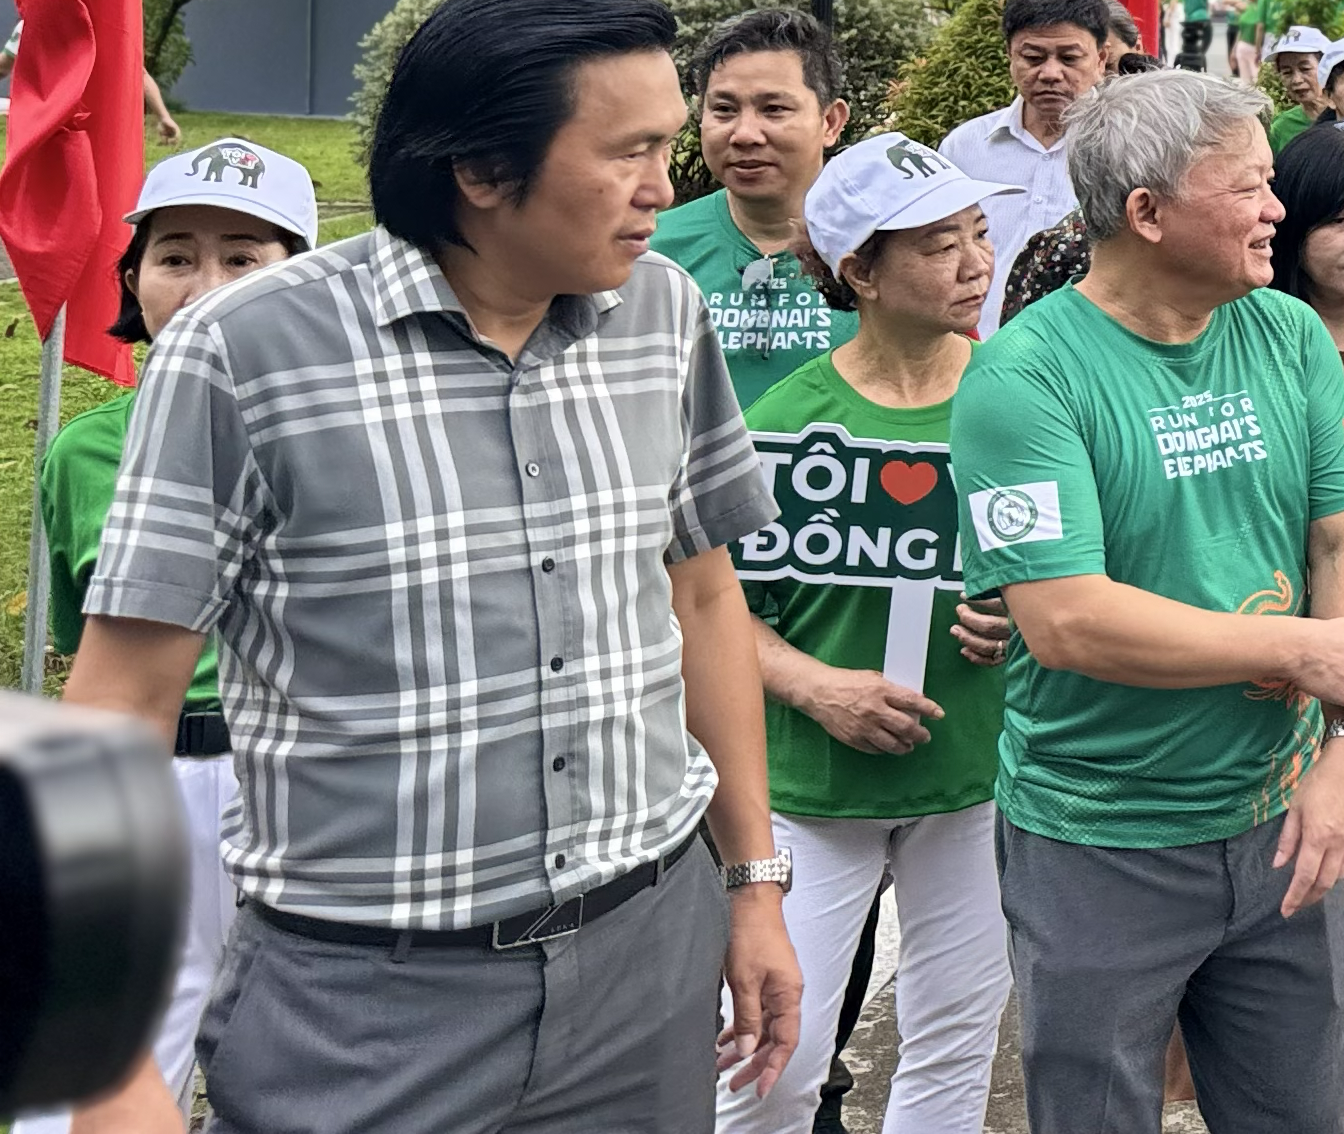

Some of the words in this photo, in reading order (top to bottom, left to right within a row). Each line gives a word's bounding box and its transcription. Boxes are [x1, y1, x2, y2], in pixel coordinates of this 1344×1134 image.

[718, 330, 831, 350] LEPHANTS
[1181, 389, 1213, 409] 2025
[1149, 412, 1199, 432] RUN
[757, 442, 870, 504] TÔI
[738, 508, 940, 570] ĐỒNG
